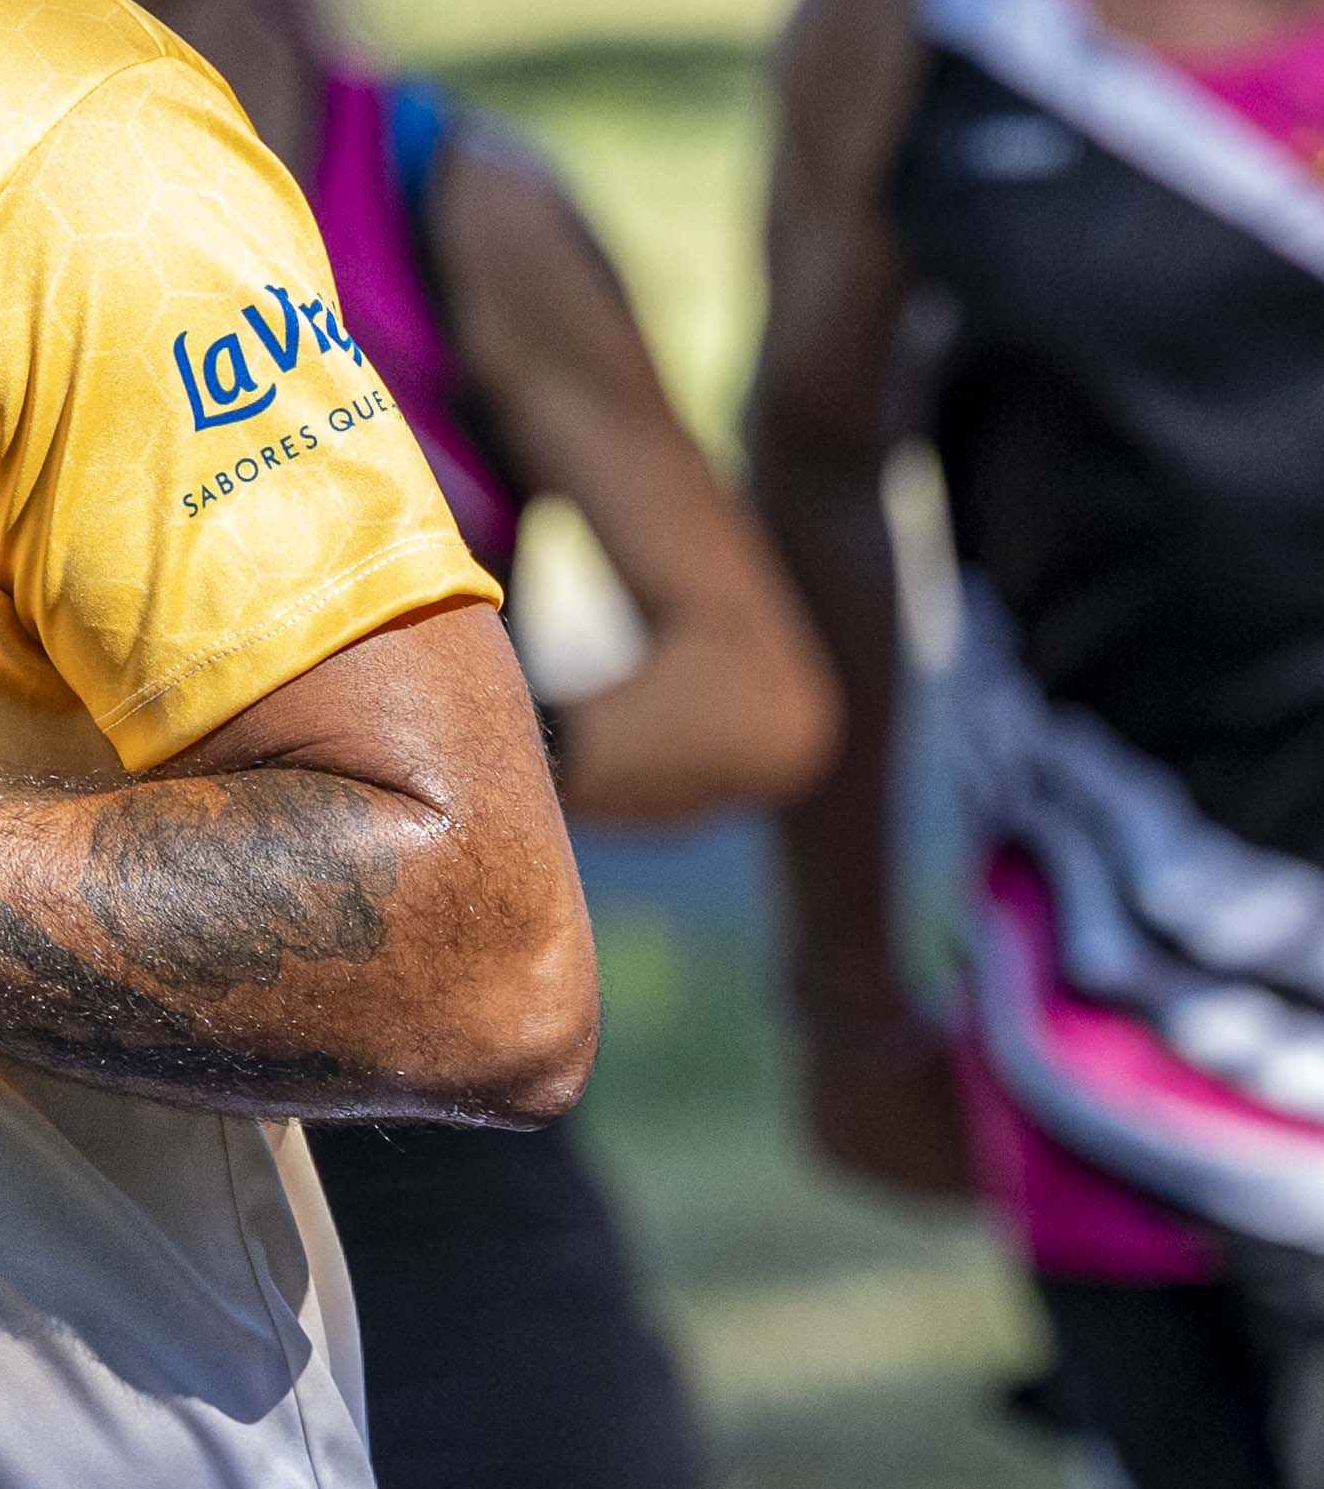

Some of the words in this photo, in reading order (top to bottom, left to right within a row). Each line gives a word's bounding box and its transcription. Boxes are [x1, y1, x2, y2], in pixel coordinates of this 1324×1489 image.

[173, 330, 277, 433] La
[182, 425, 319, 518] SABORES
[328, 390, 390, 433] QUE
